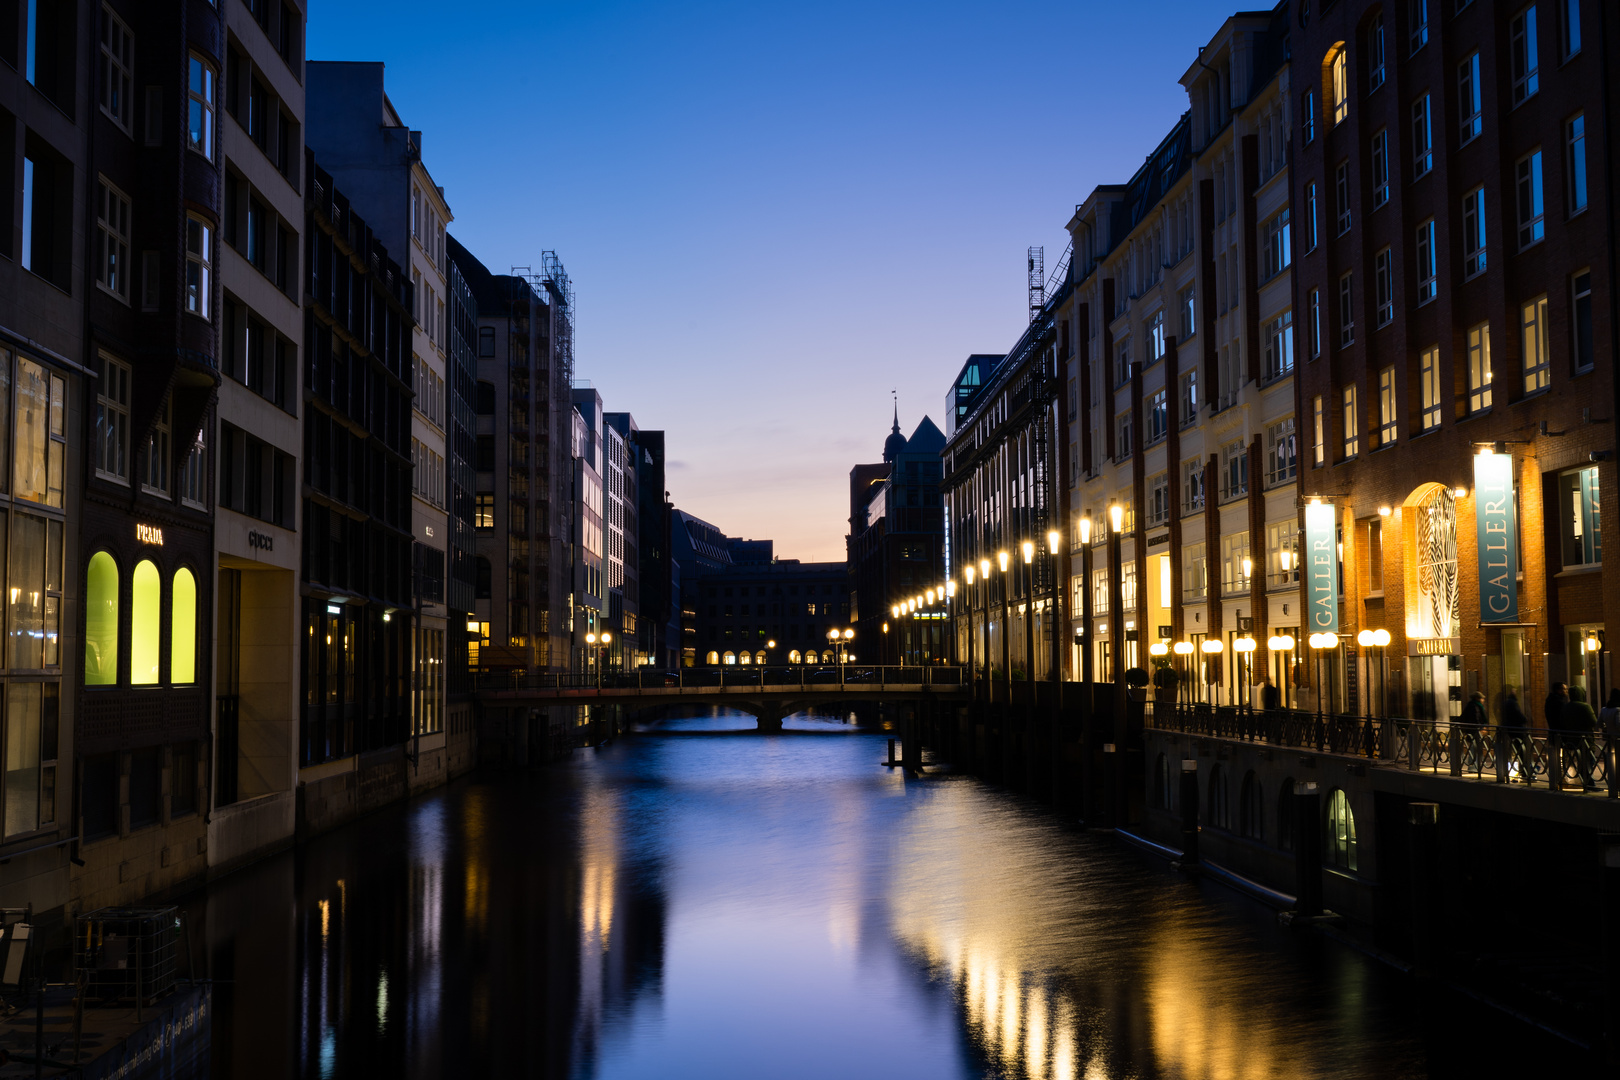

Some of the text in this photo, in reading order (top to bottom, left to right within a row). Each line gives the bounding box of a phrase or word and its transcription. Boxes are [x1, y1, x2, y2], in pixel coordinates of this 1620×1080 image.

[136, 523, 163, 546] PRADA
[248, 530, 273, 551] GUCCI
[1484, 475, 1510, 613] GALLERI
[1314, 523, 1333, 627] GALLERI
[1416, 638, 1453, 655] GALLERIA
